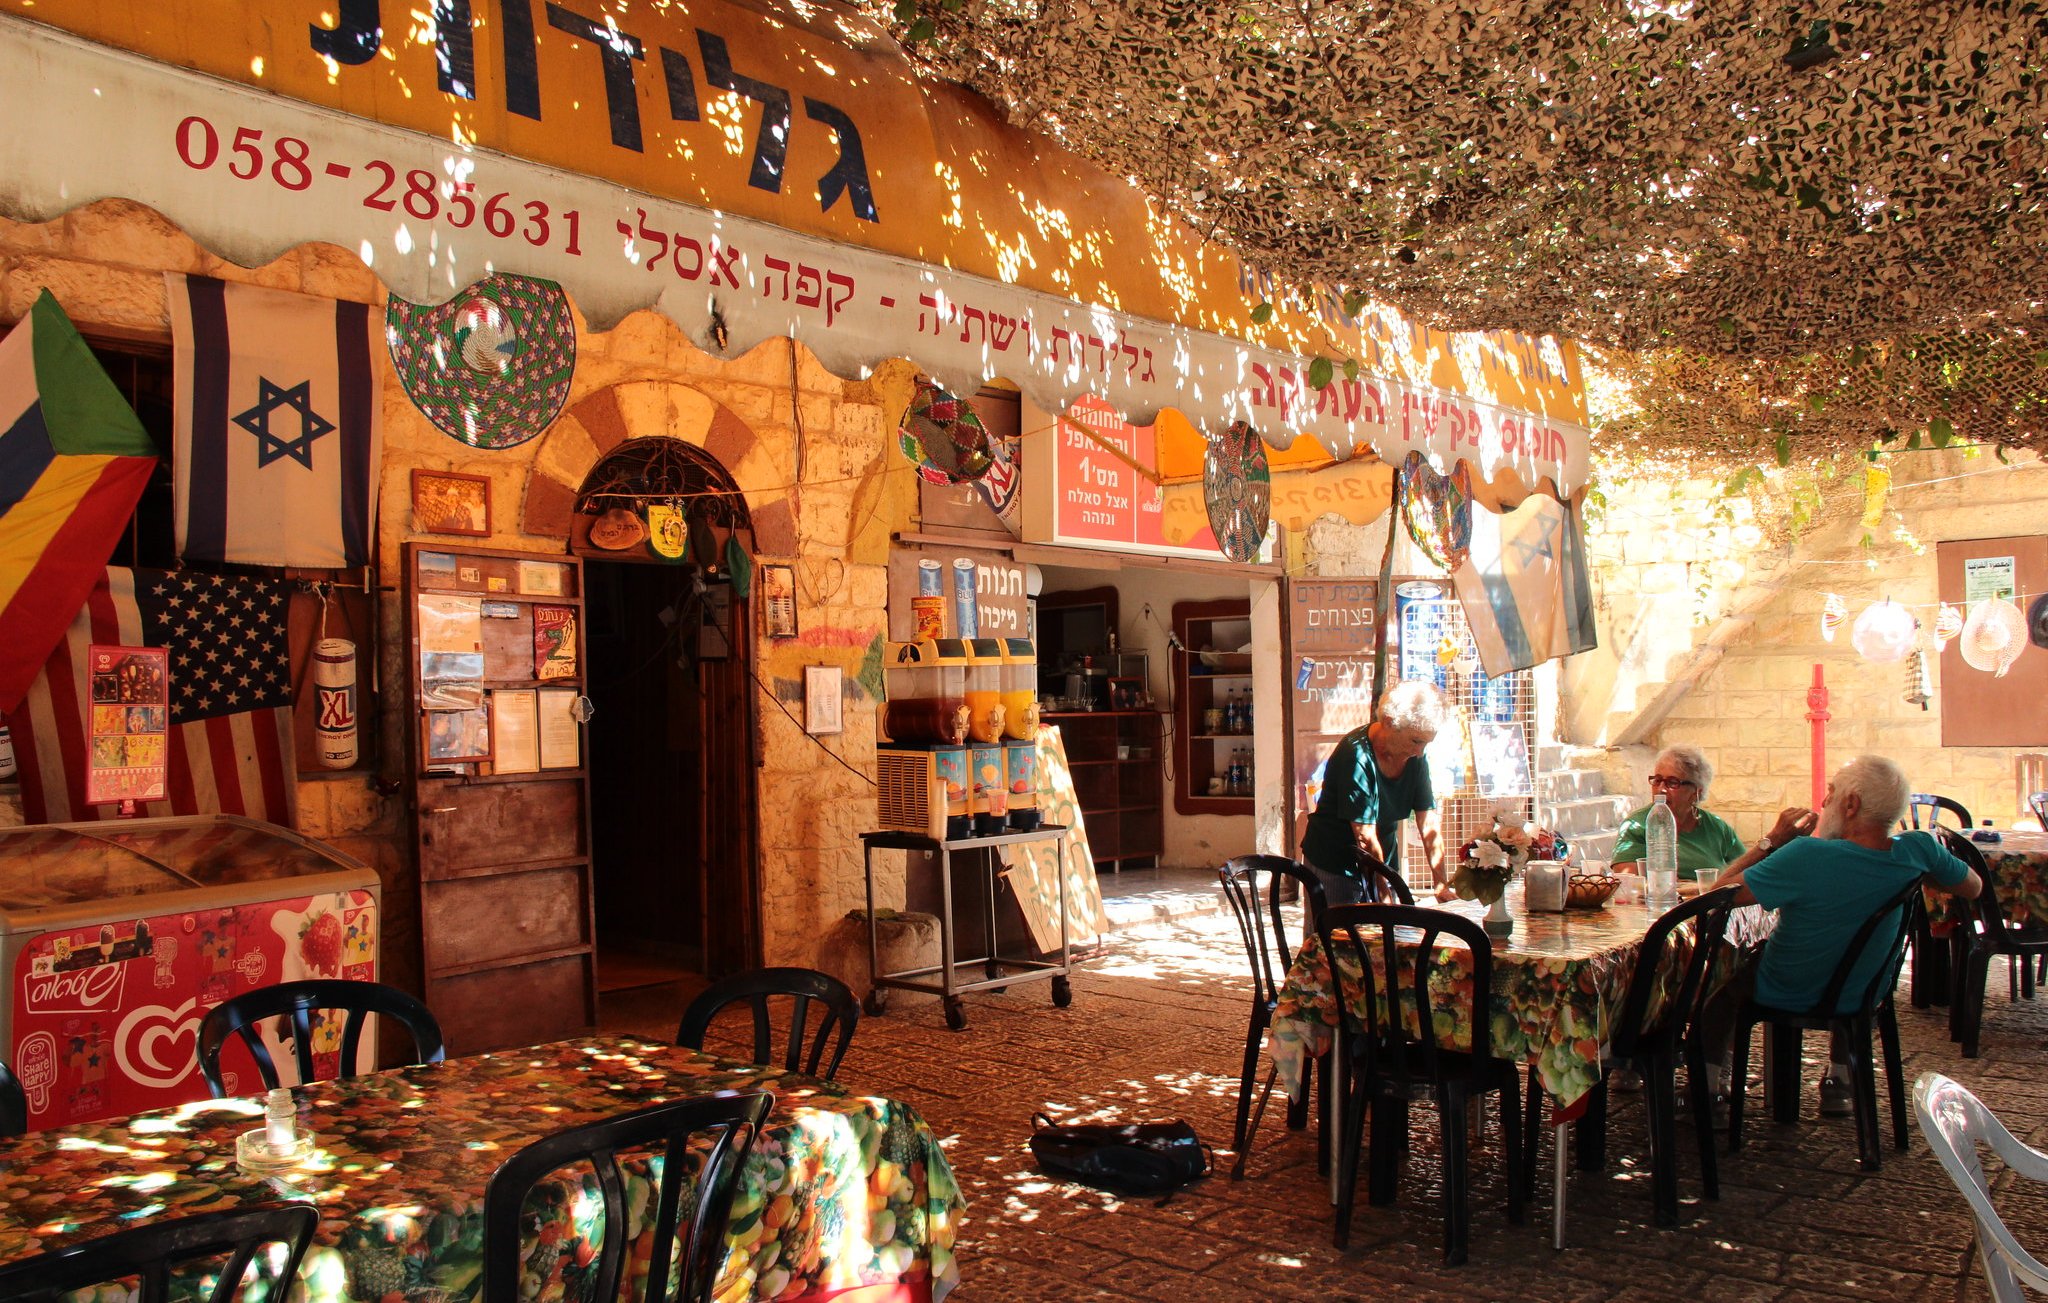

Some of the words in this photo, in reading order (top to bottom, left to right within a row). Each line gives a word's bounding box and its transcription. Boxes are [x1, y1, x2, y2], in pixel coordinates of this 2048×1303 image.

[175, 116, 582, 256] 058-285631
[616, 207, 740, 290] אסלי
[763, 253, 855, 328] קפה
[918, 291, 1031, 357] ושתיה
[1051, 324, 1156, 383] גלידות
[1070, 405, 1123, 431] החומוס
[1402, 391, 1484, 452] פקיעין
[1499, 418, 1567, 466] חומוס
[979, 457, 1016, 508] XL
[1068, 487, 1102, 506] סאלח
[1105, 491, 1129, 510] אצל
[1082, 510, 1116, 526] ונזהה
[977, 563, 1023, 597] חנות
[1308, 607, 1374, 626] פצוחים
[1315, 656, 1375, 680] פילמים
[320, 689, 355, 729] XL
